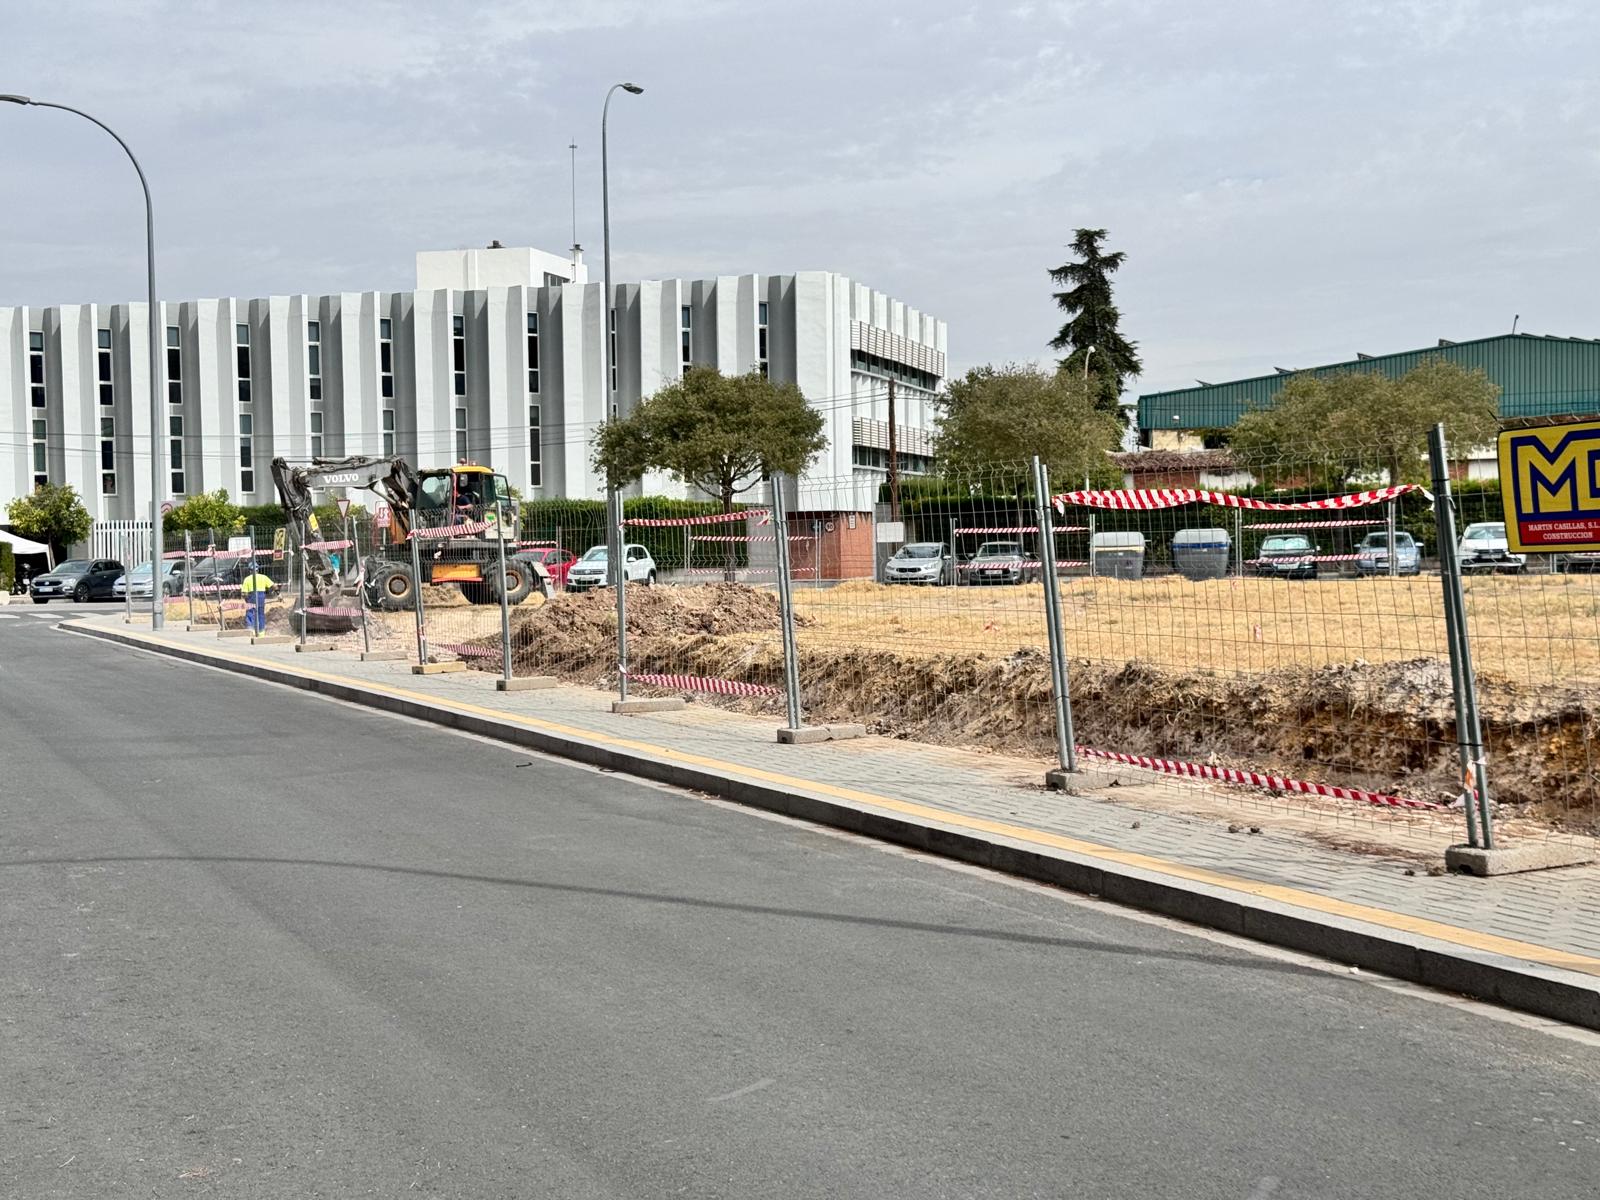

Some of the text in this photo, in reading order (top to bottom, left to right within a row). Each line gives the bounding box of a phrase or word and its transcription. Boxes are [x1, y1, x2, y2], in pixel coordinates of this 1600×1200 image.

[323, 473, 359, 484] VOLVO
[1528, 523, 1553, 532] MARTIN
[1554, 522, 1587, 530] CASILLAS,
[1543, 532, 1593, 540] CONSTRUCCION
